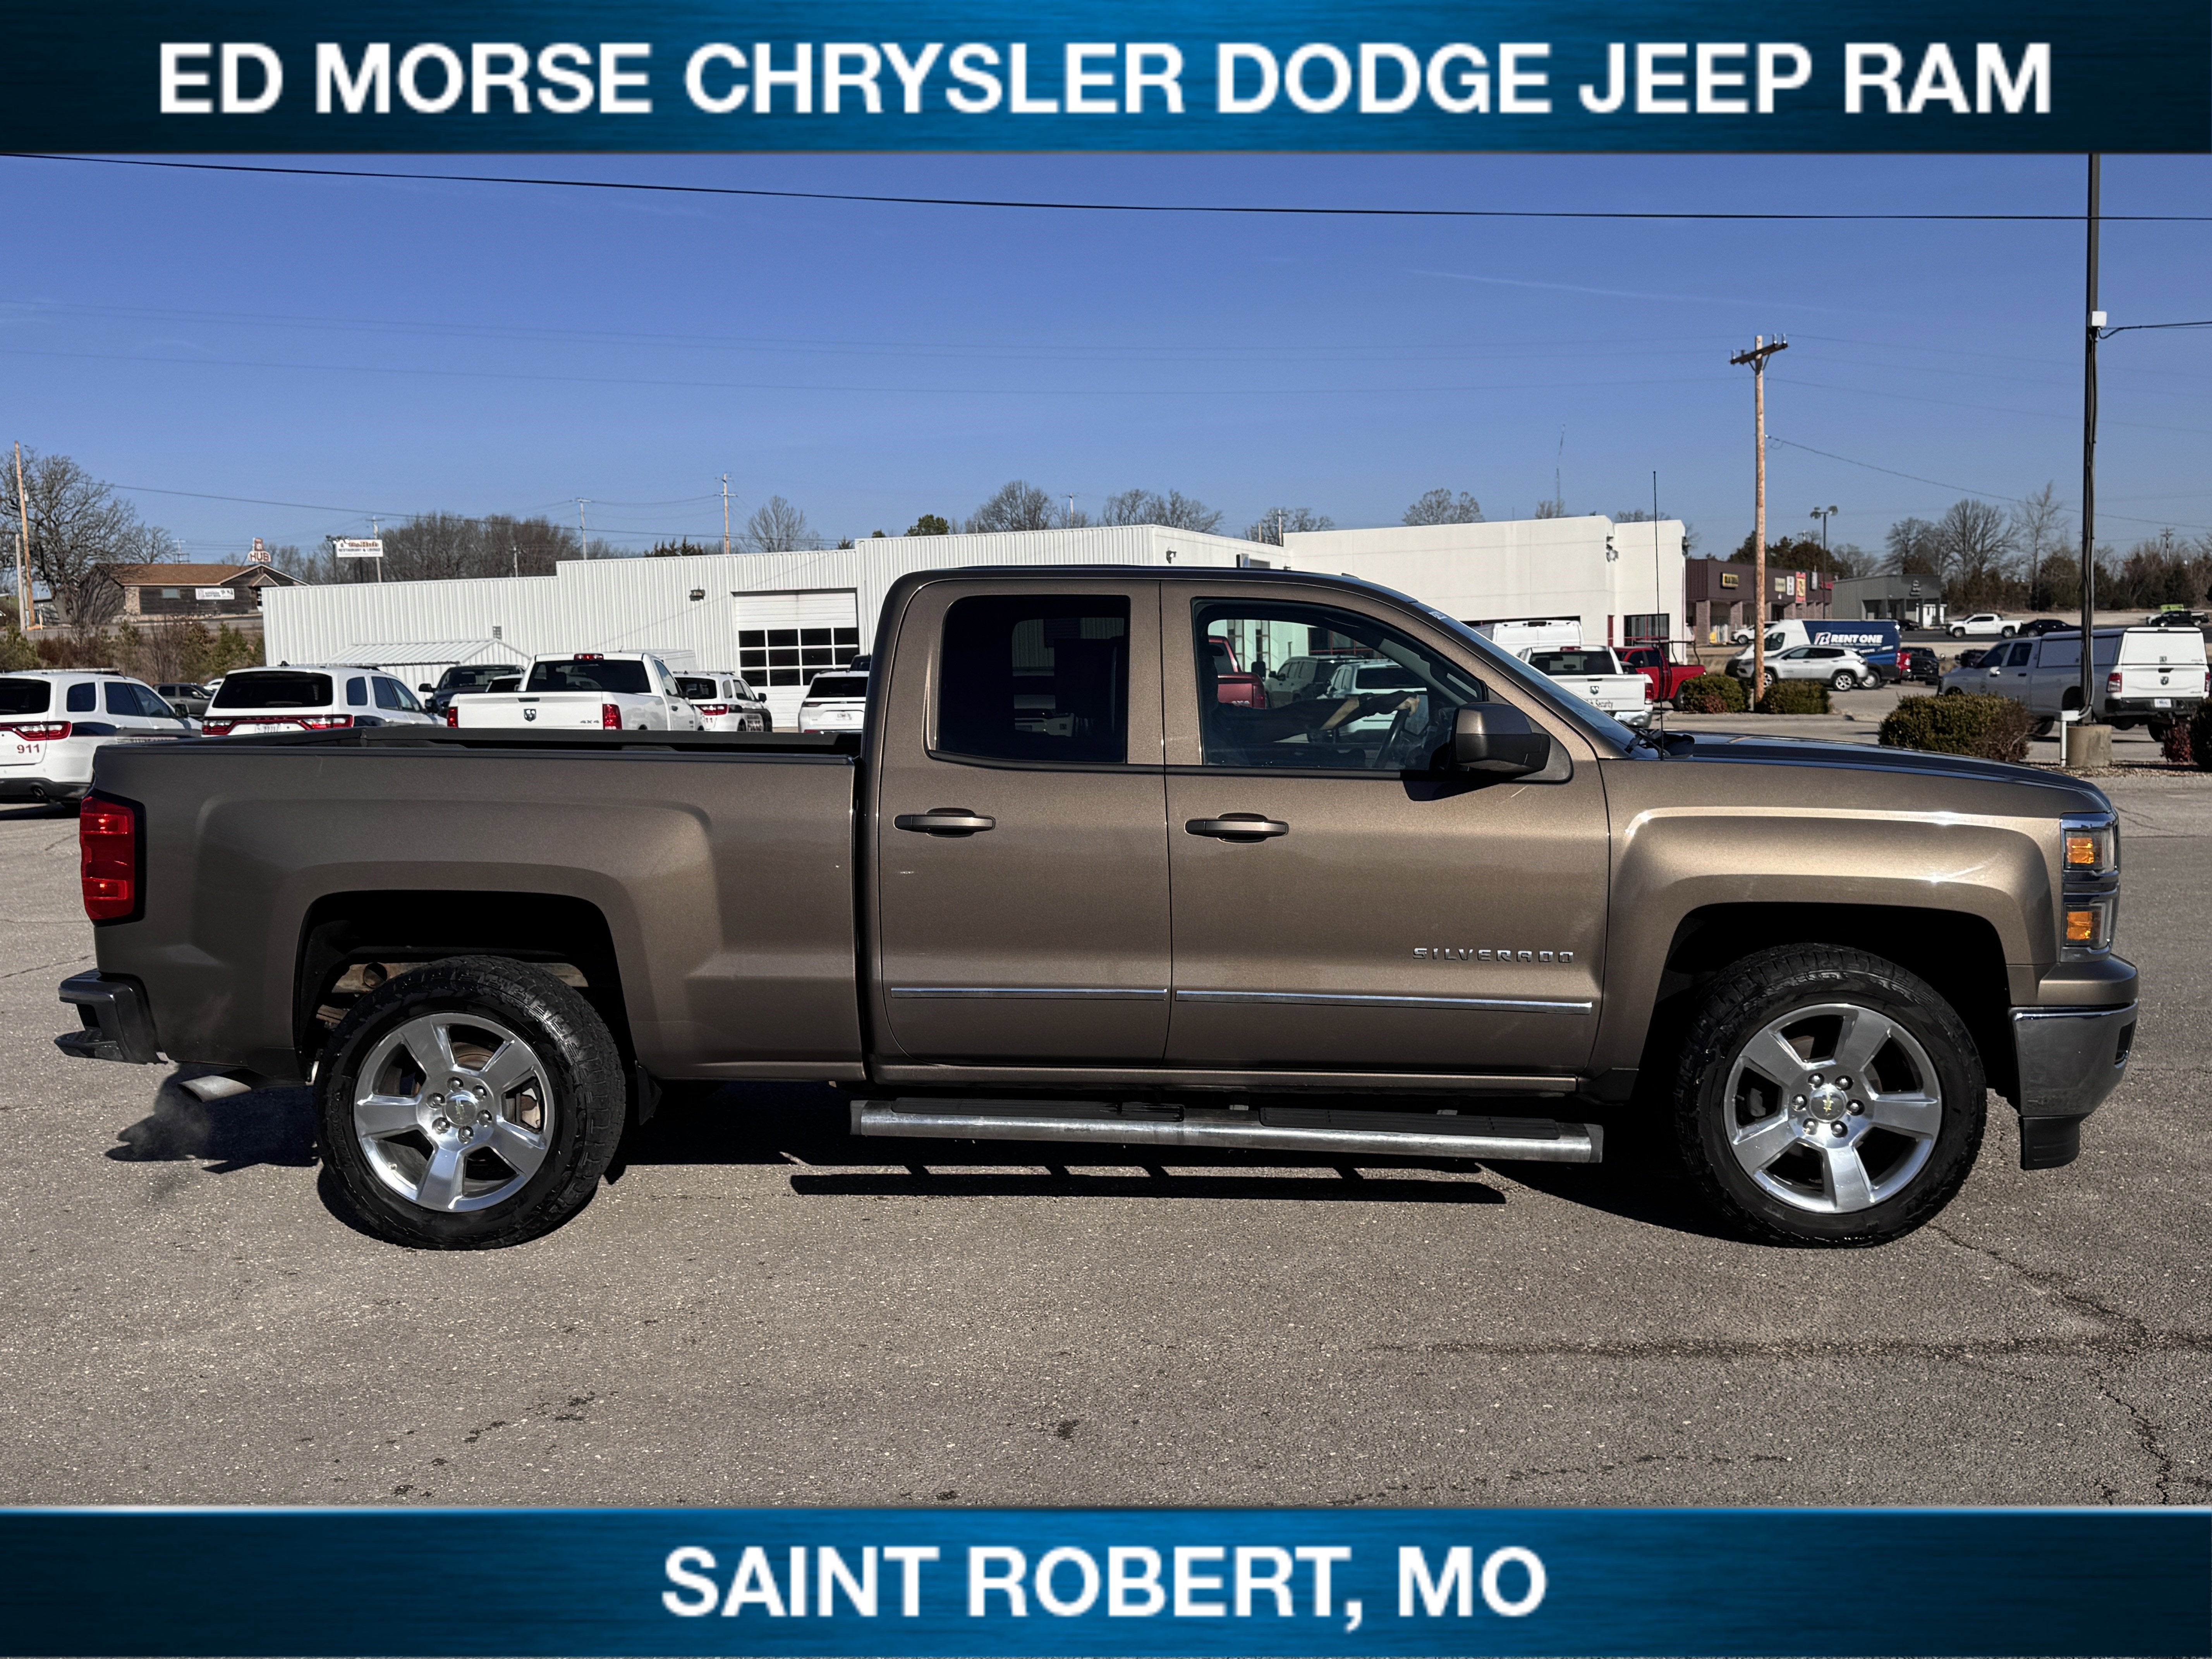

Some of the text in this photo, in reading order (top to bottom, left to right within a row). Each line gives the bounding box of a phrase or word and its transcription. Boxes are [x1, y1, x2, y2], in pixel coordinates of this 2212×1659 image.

[249, 552, 269, 561] HUB
[1831, 634, 1883, 643] RENT ONE
[17, 744, 40, 754] 911
[1413, 948, 1574, 963] SILVERADO
